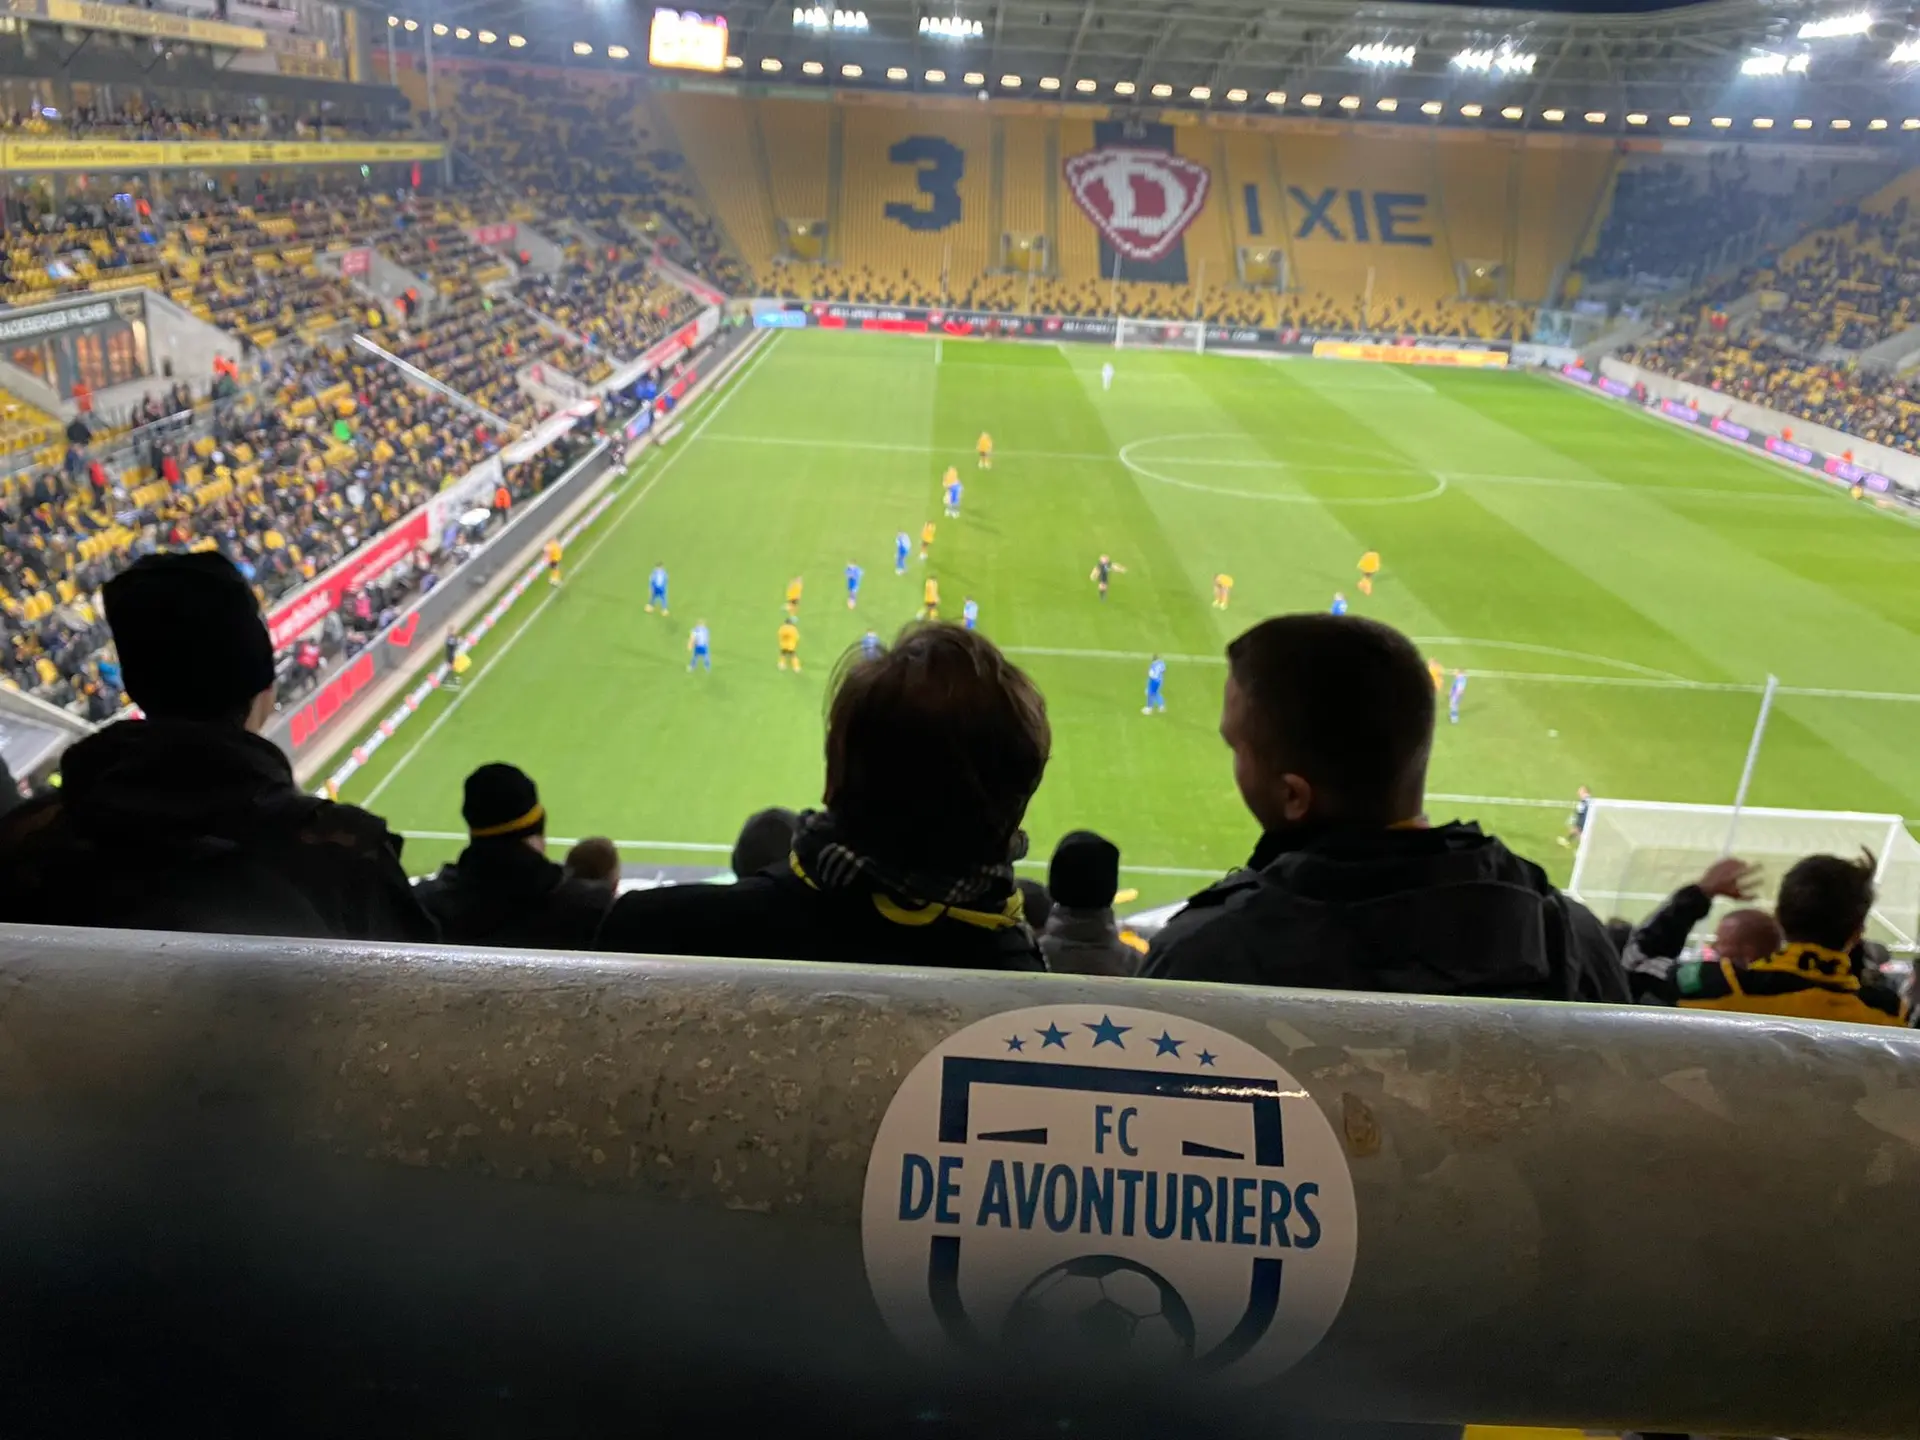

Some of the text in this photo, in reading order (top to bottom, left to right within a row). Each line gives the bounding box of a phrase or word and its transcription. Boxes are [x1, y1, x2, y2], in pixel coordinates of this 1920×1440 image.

[884, 136, 964, 231] 3
[1094, 1105, 1139, 1156] FC
[898, 1153, 1321, 1249] DE AVONTURIERS
